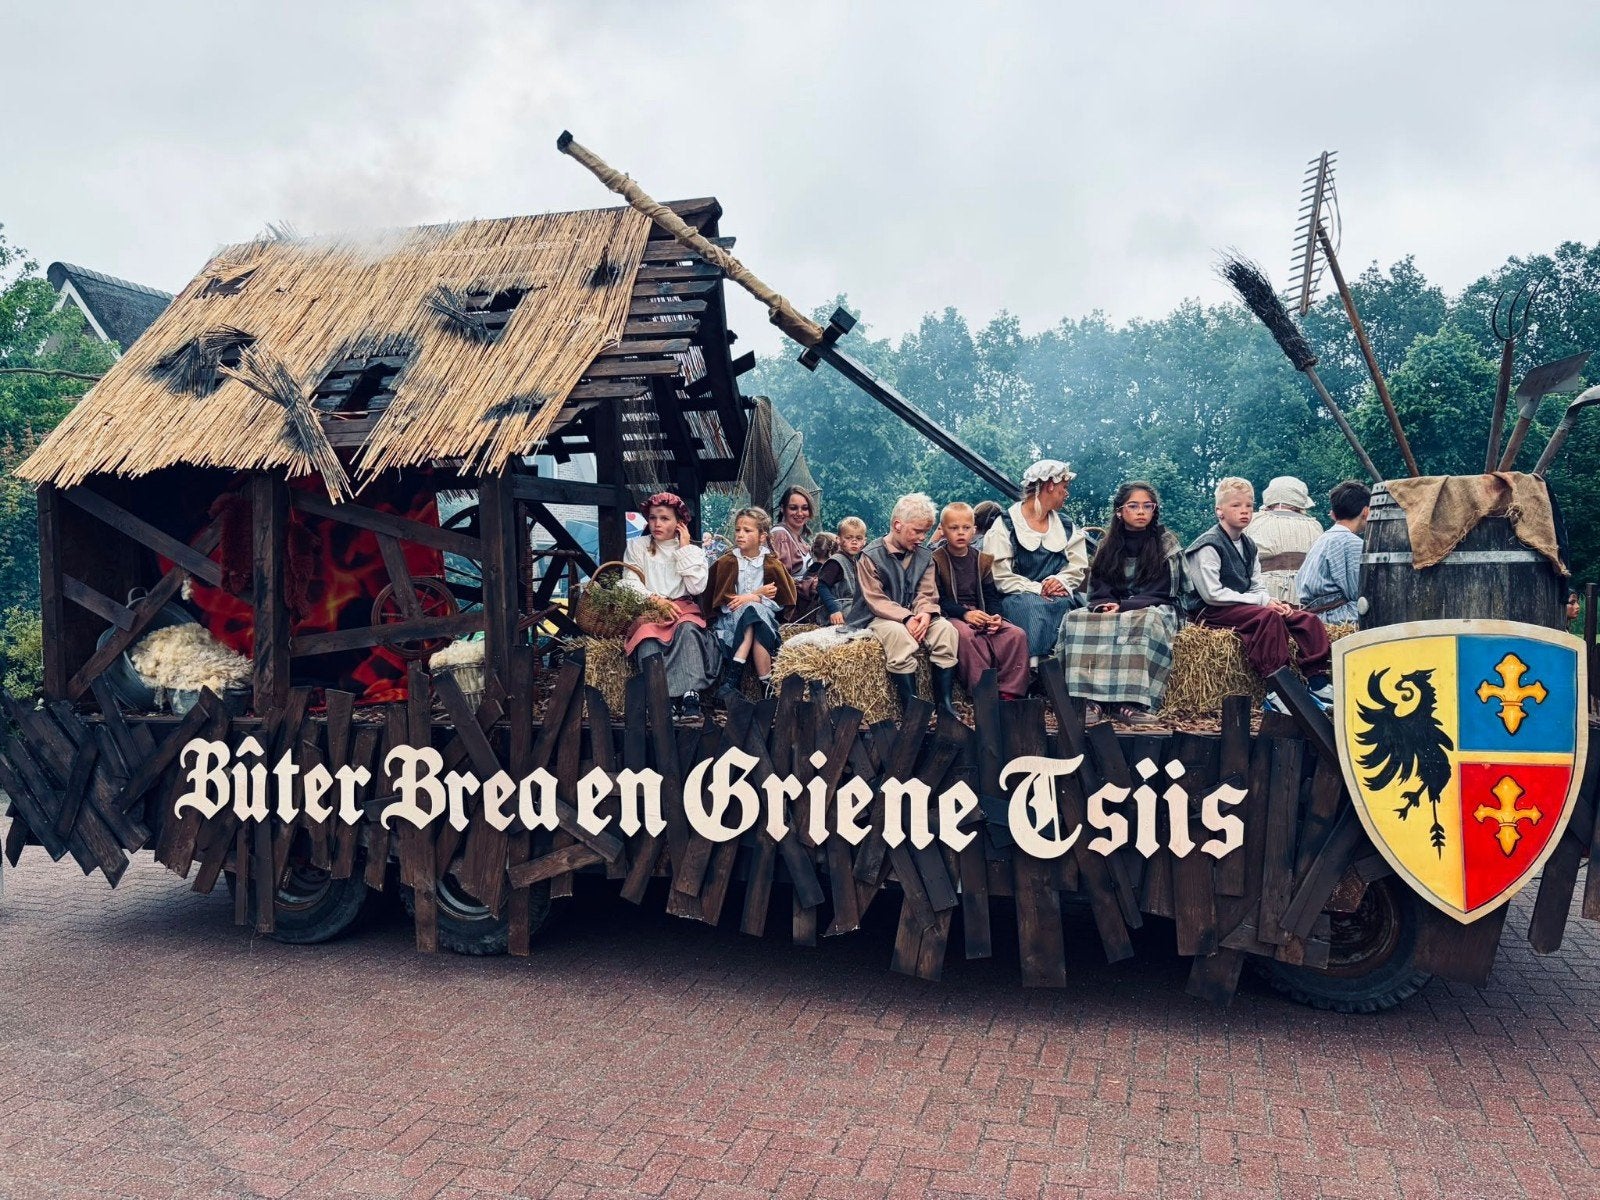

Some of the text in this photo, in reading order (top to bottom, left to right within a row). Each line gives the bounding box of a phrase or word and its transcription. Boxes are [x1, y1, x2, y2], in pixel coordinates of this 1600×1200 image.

[174, 735, 1249, 859] Bûter Brea en Griene Tsiis
